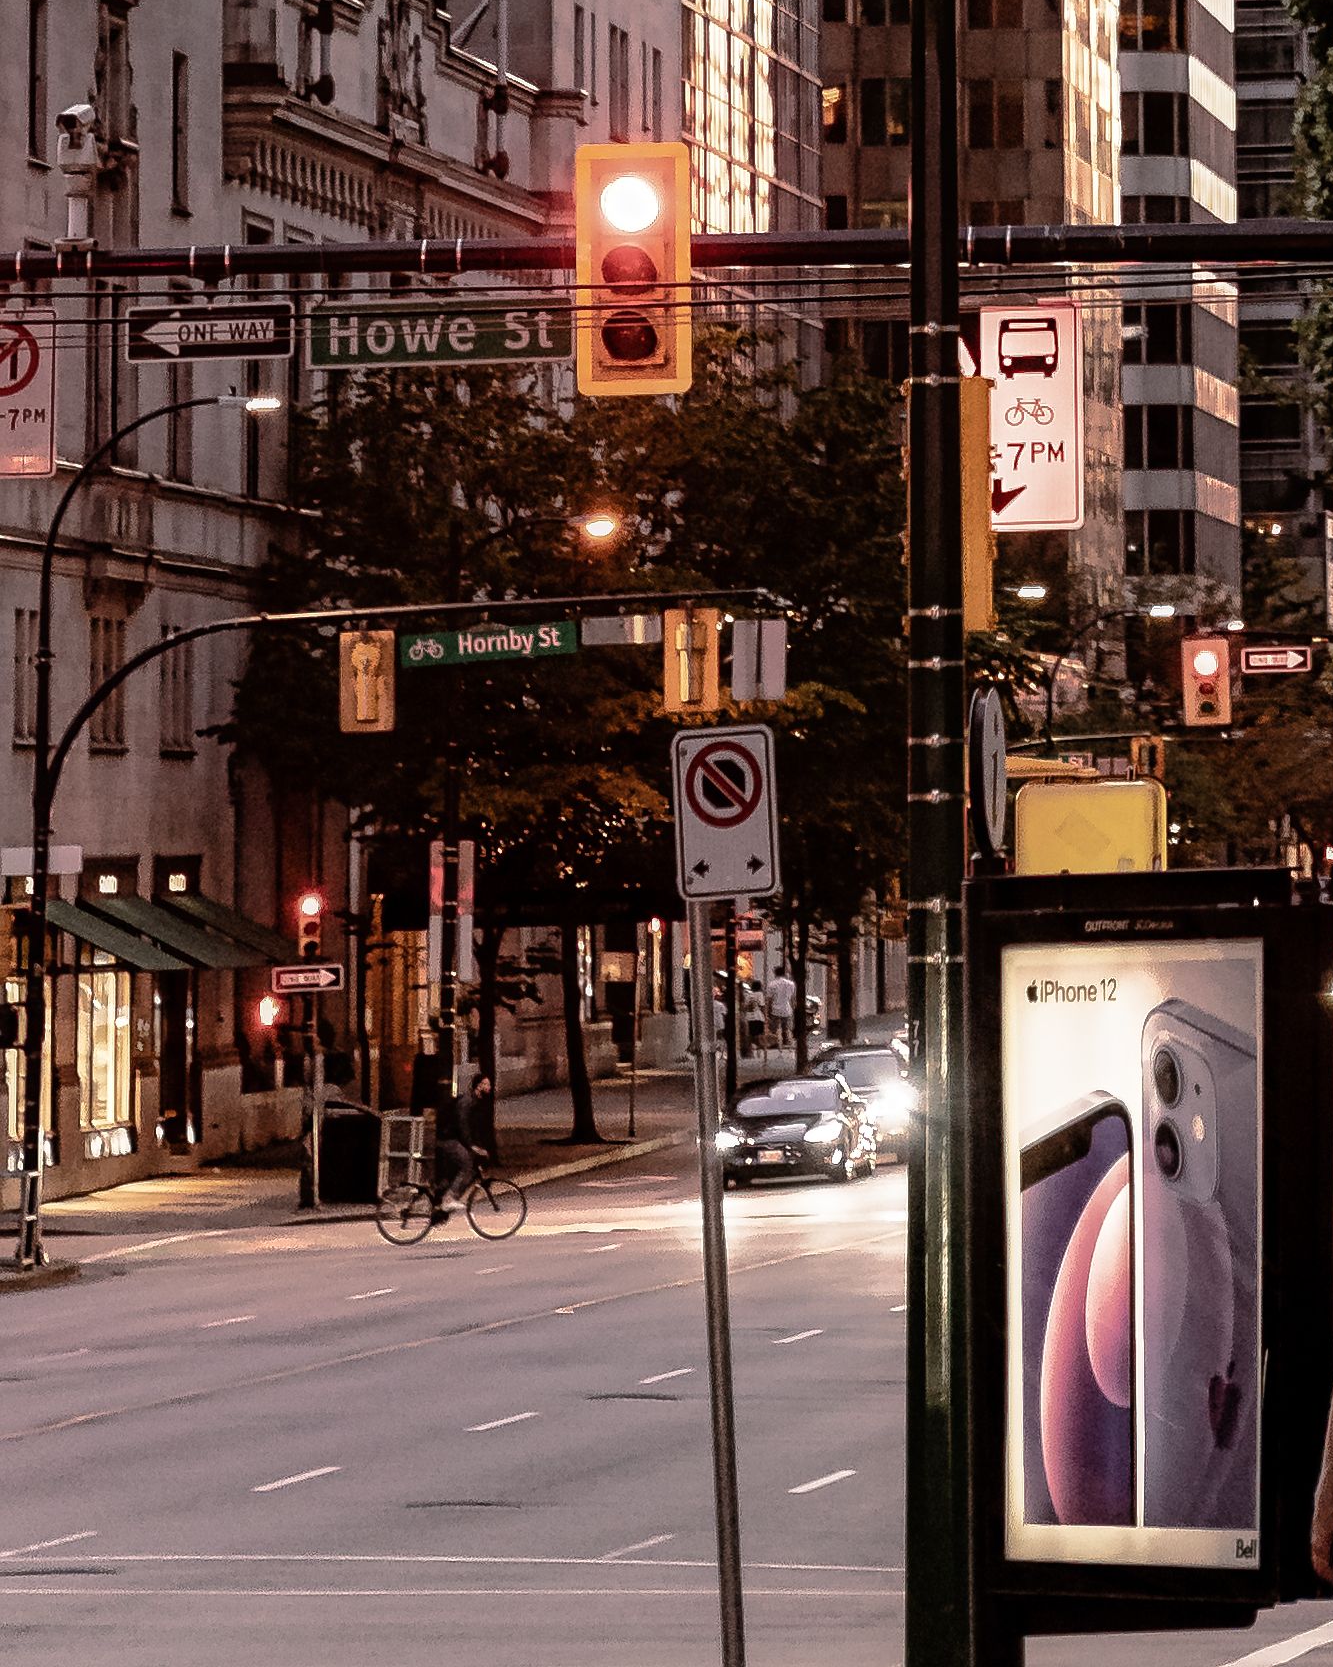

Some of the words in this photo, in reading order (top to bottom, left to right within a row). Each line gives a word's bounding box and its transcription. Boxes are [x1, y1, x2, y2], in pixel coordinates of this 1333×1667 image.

[177, 322, 219, 343] ONE
[228, 320, 272, 341] WAY
[329, 315, 476, 356] Howe
[503, 311, 554, 350] St
[457, 628, 534, 656] Hornby
[537, 626, 562, 648] St
[1039, 979, 1098, 1003] iPhone
[1099, 977, 1117, 1002] 12
[1235, 1537, 1257, 1559] Bell
